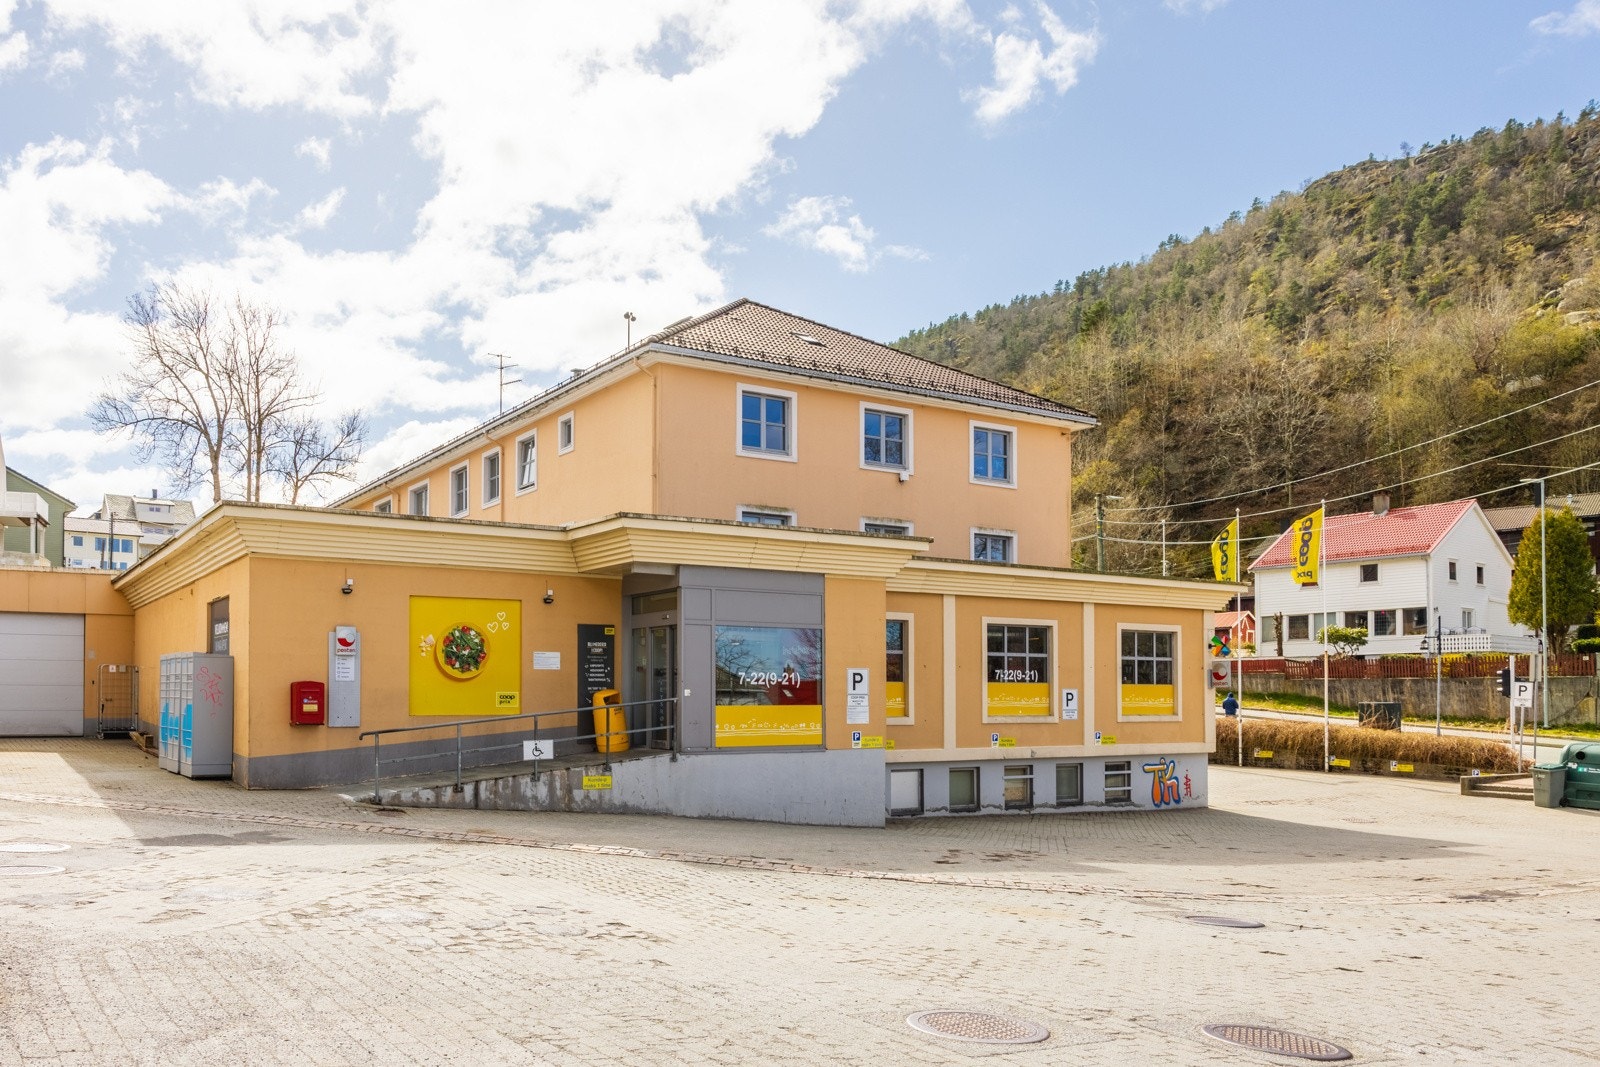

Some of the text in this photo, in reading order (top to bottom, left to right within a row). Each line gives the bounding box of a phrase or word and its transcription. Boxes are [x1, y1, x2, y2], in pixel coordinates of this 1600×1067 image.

[738, 671, 801, 688] 7-22(9-21)
[853, 673, 863, 690] P
[995, 670, 1038, 682] 7-22(9-21)
[1518, 685, 1527, 696] P
[1066, 692, 1073, 707] P
